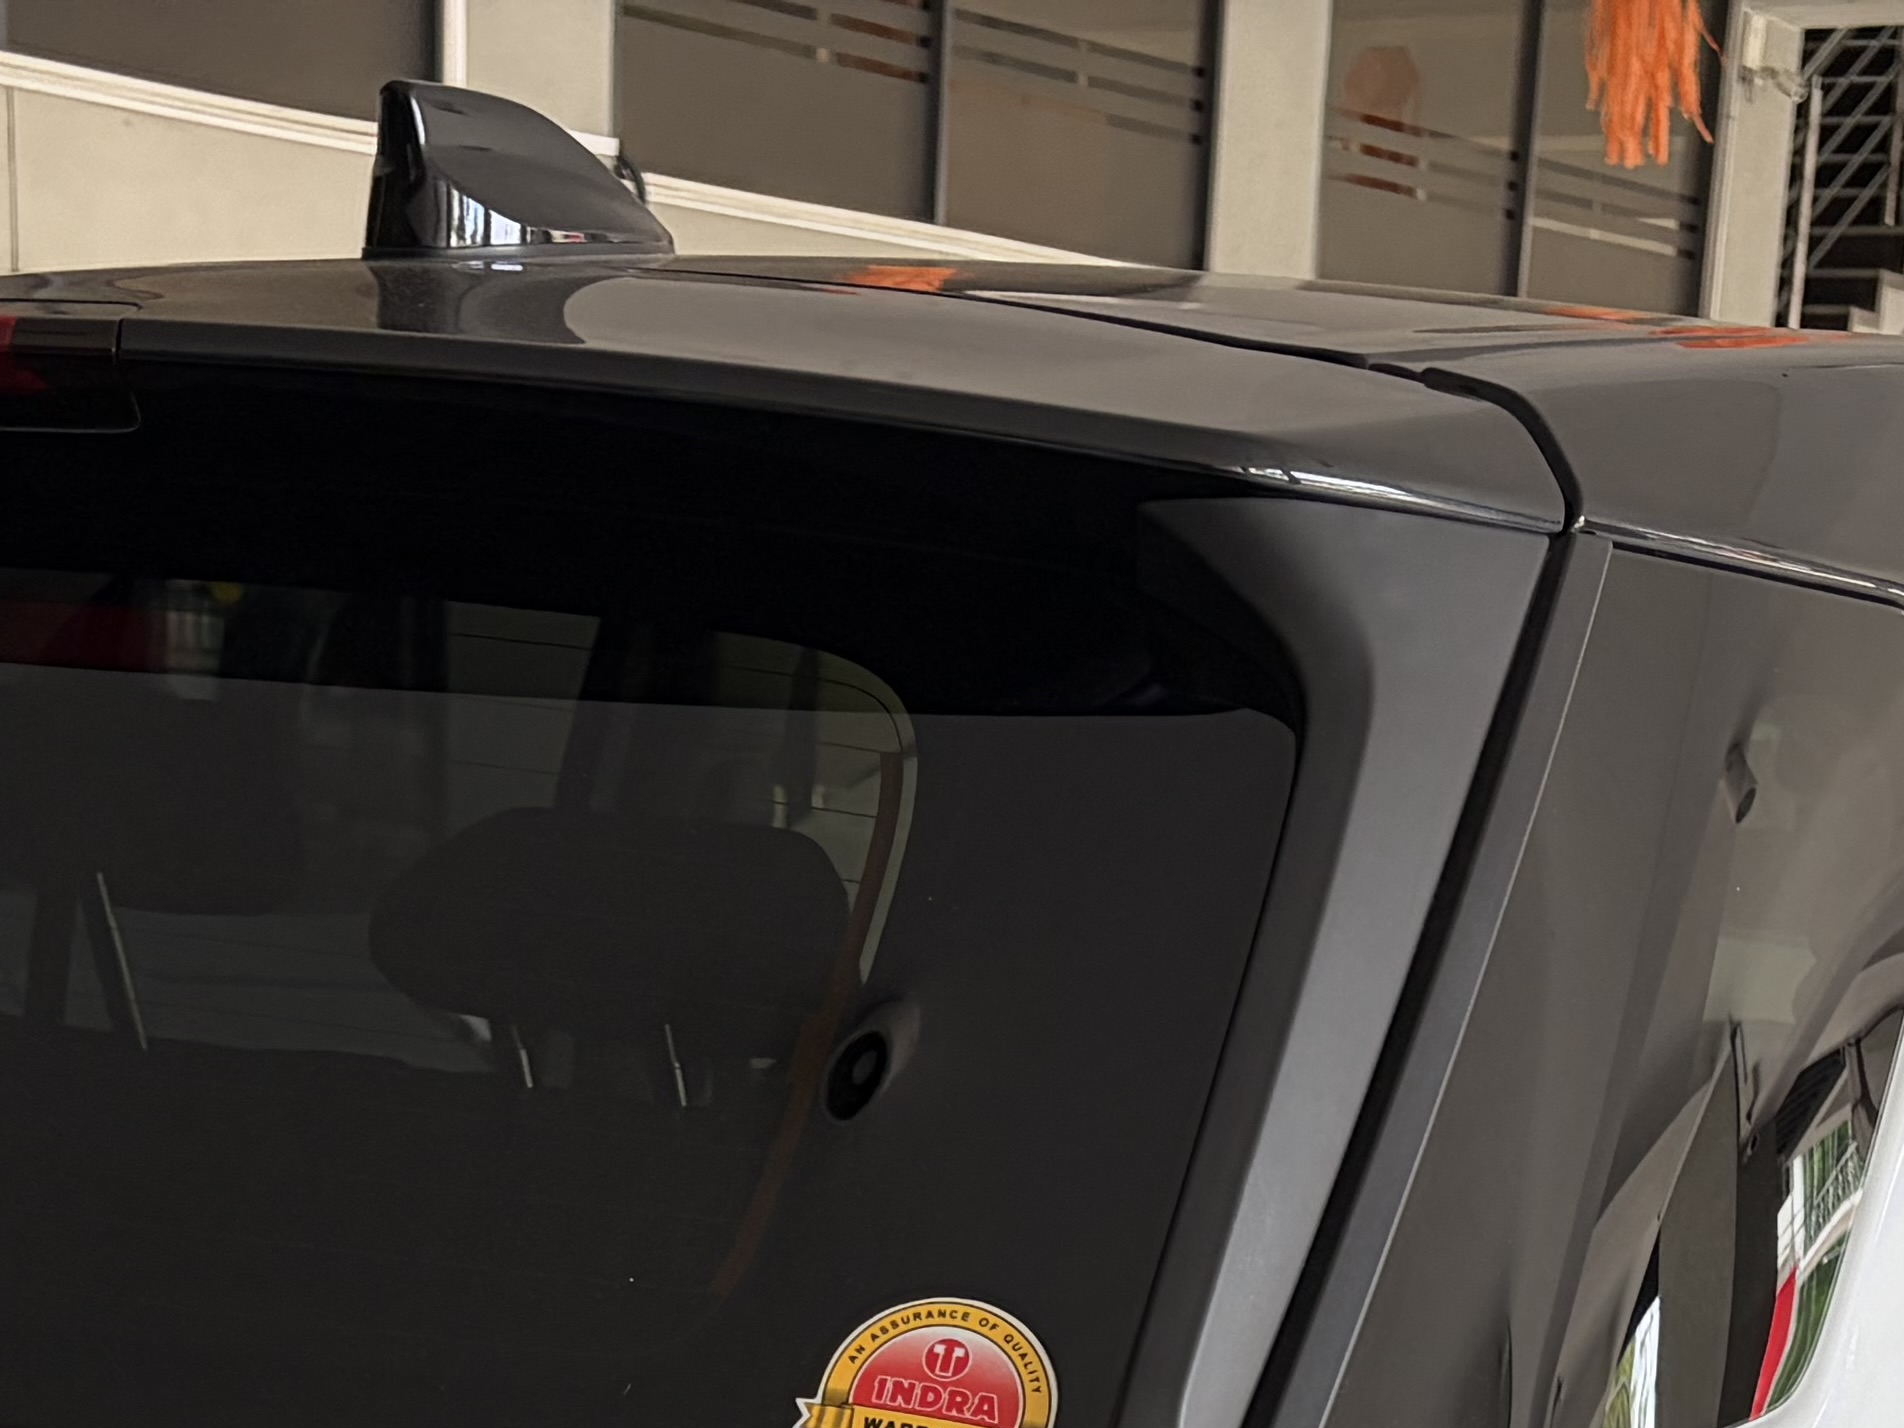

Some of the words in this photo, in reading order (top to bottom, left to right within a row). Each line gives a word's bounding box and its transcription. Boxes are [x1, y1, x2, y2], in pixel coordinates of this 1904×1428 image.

[848, 1344, 866, 1364] AN
[869, 1309, 971, 1342] ASSURANCE
[978, 1317, 1000, 1331] OF
[1003, 1333, 1042, 1393] QUALITY
[871, 1375, 999, 1424] INDRA
